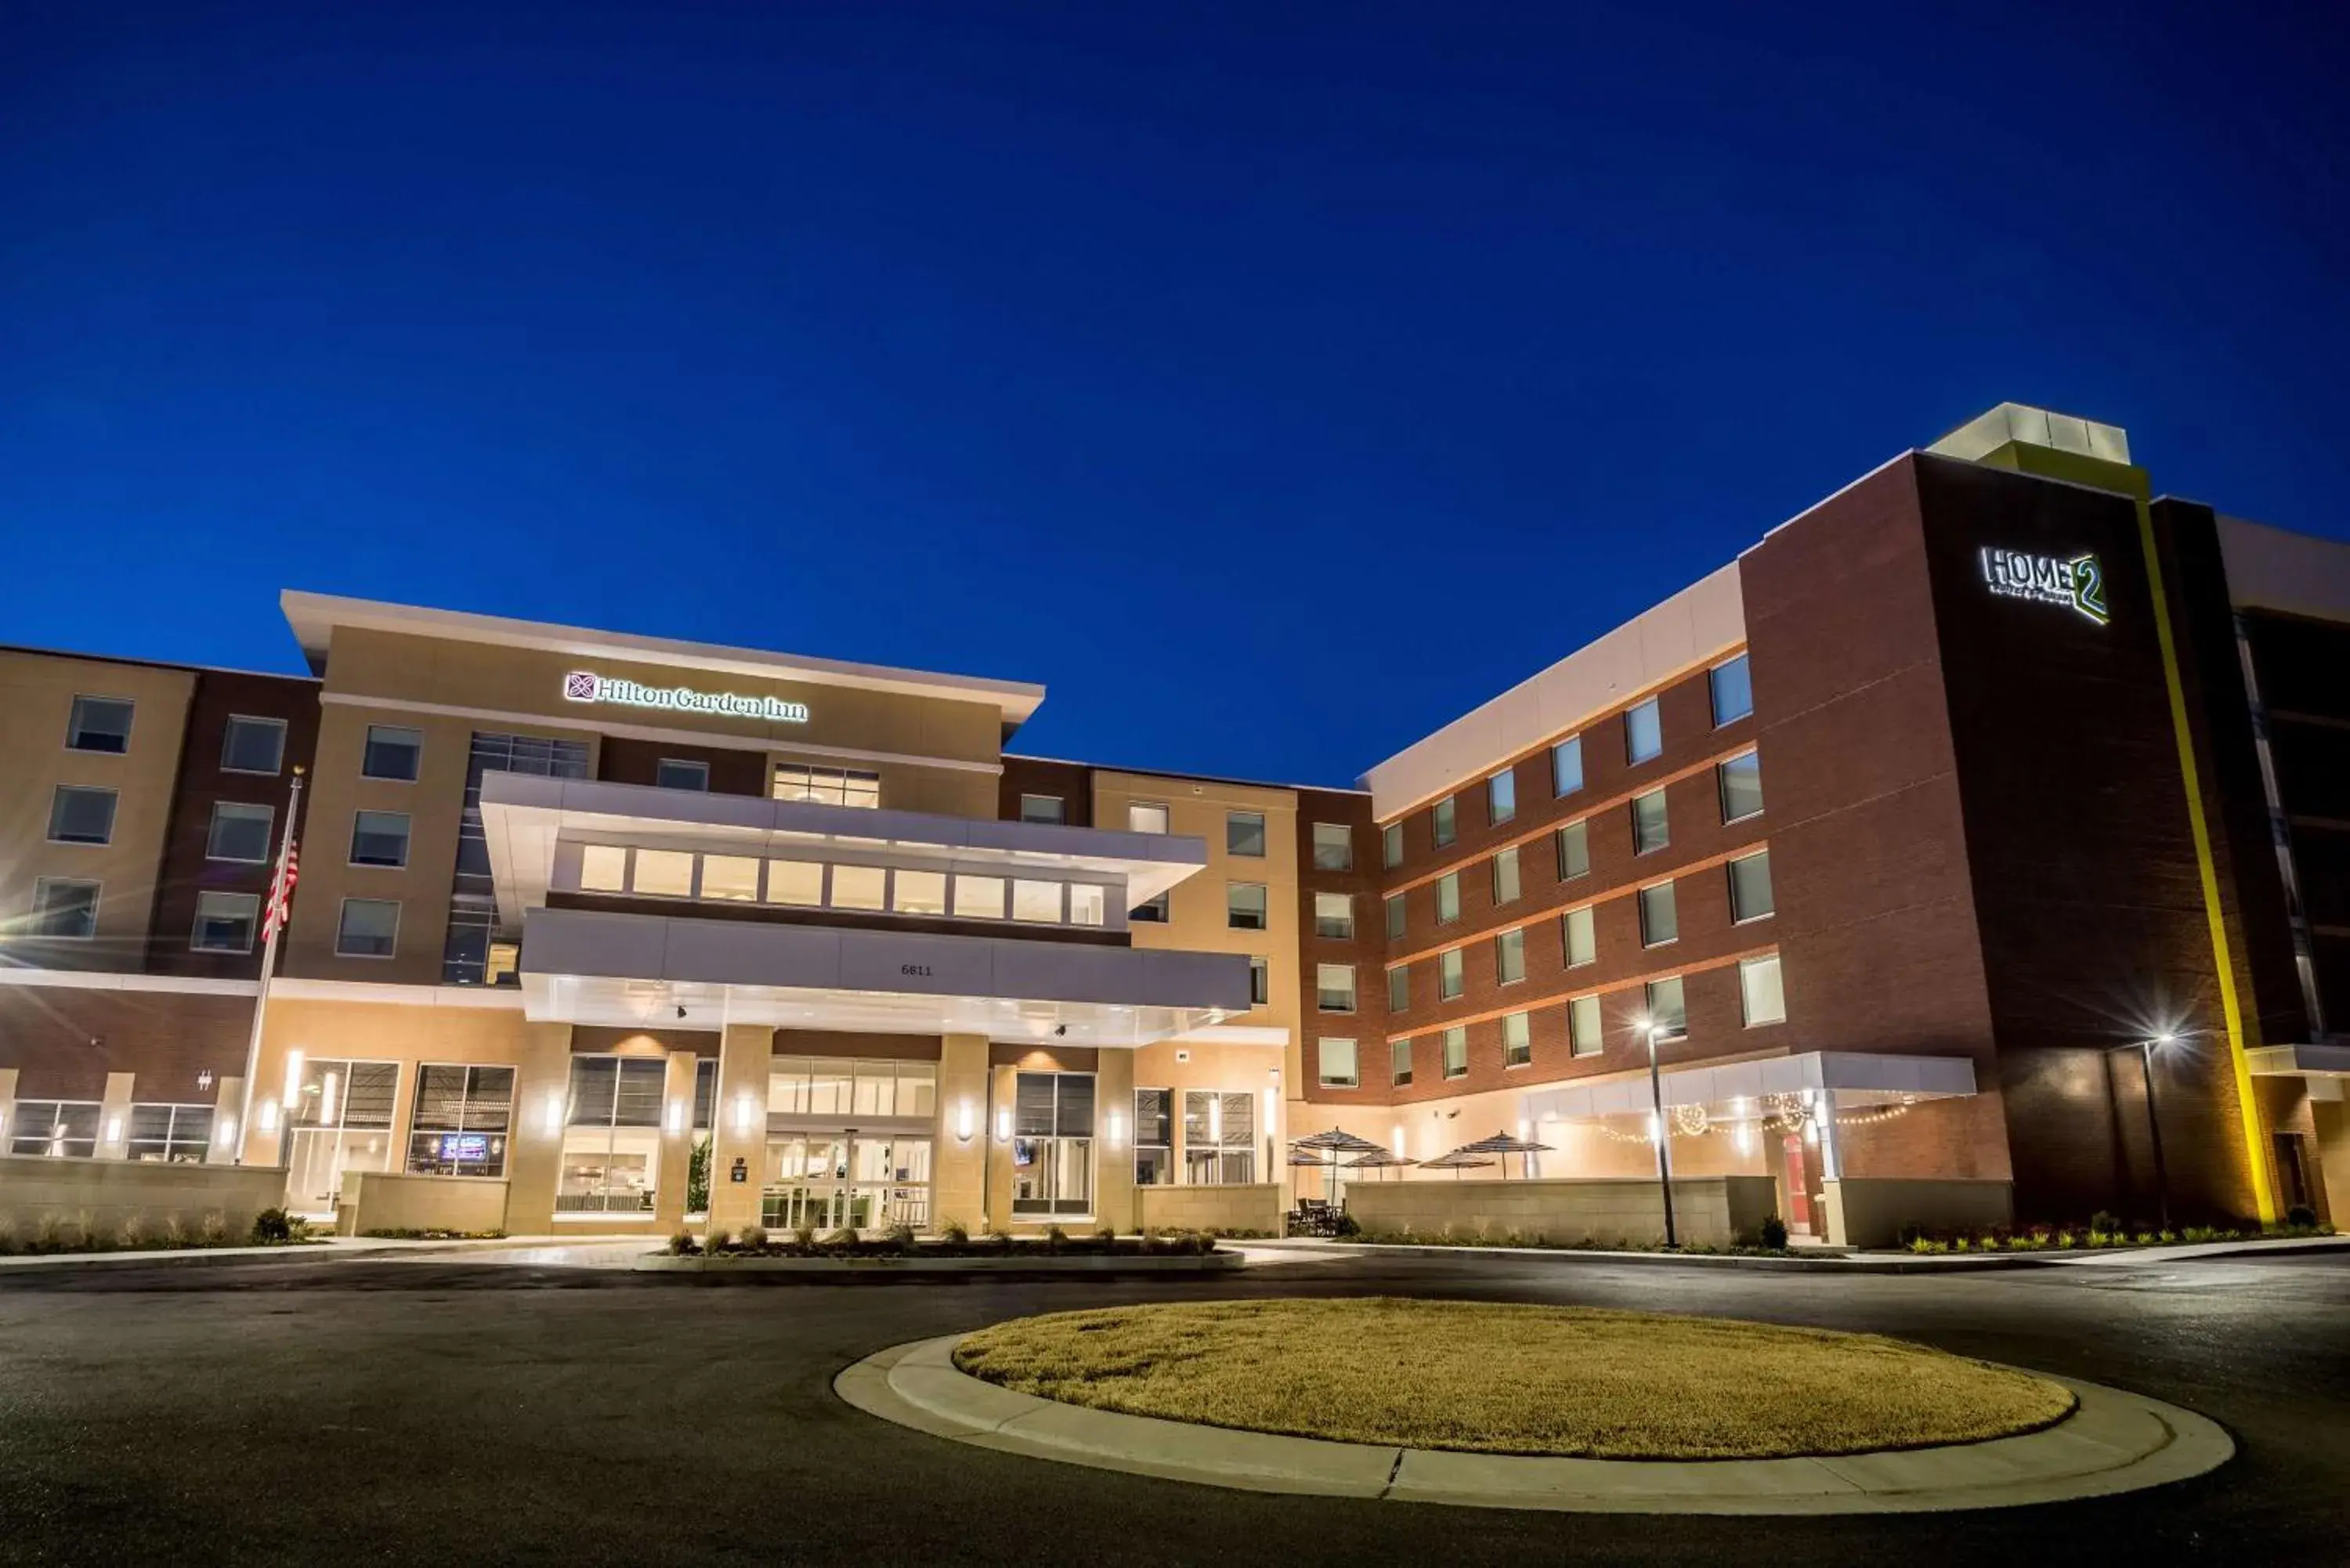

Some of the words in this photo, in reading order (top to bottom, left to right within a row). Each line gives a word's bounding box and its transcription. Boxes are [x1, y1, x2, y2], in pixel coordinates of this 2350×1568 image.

[598, 679, 672, 705] Hilton
[676, 688, 761, 715] Garden
[765, 697, 808, 720] Inn
